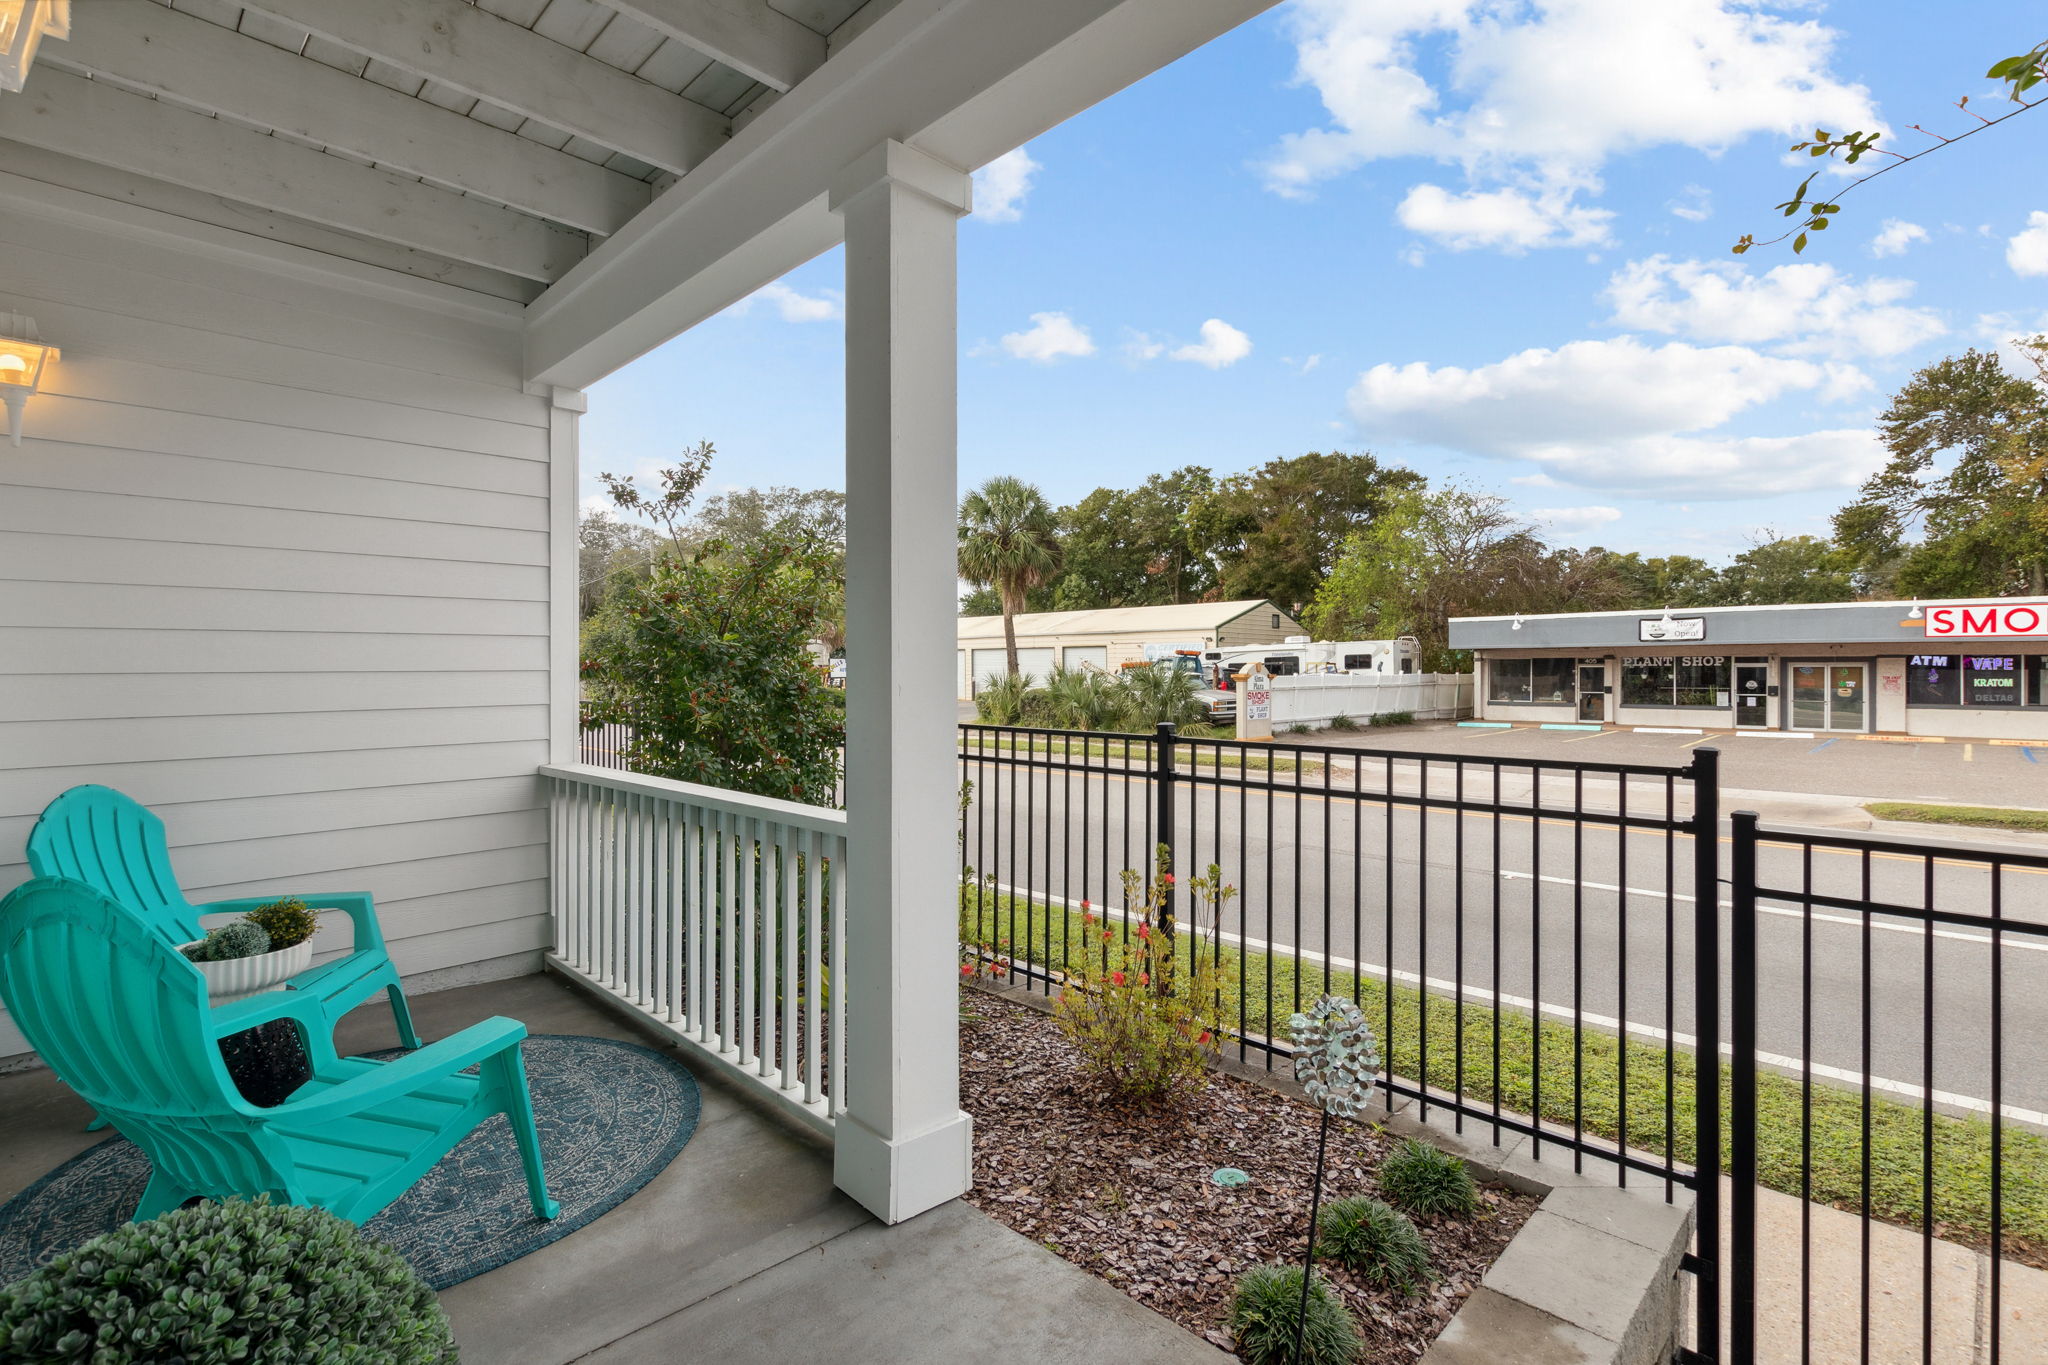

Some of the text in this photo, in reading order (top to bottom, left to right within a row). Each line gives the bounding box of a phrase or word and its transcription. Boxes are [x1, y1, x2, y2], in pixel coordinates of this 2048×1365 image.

[1933, 607, 2048, 634] SMO
[1623, 656, 1725, 667] PLANT SHOP
[1910, 655, 1948, 667] ATM
[1971, 657, 2014, 670] VAPE
[1973, 678, 2014, 687] KRATOM
[1247, 691, 1270, 700] SMOKE
